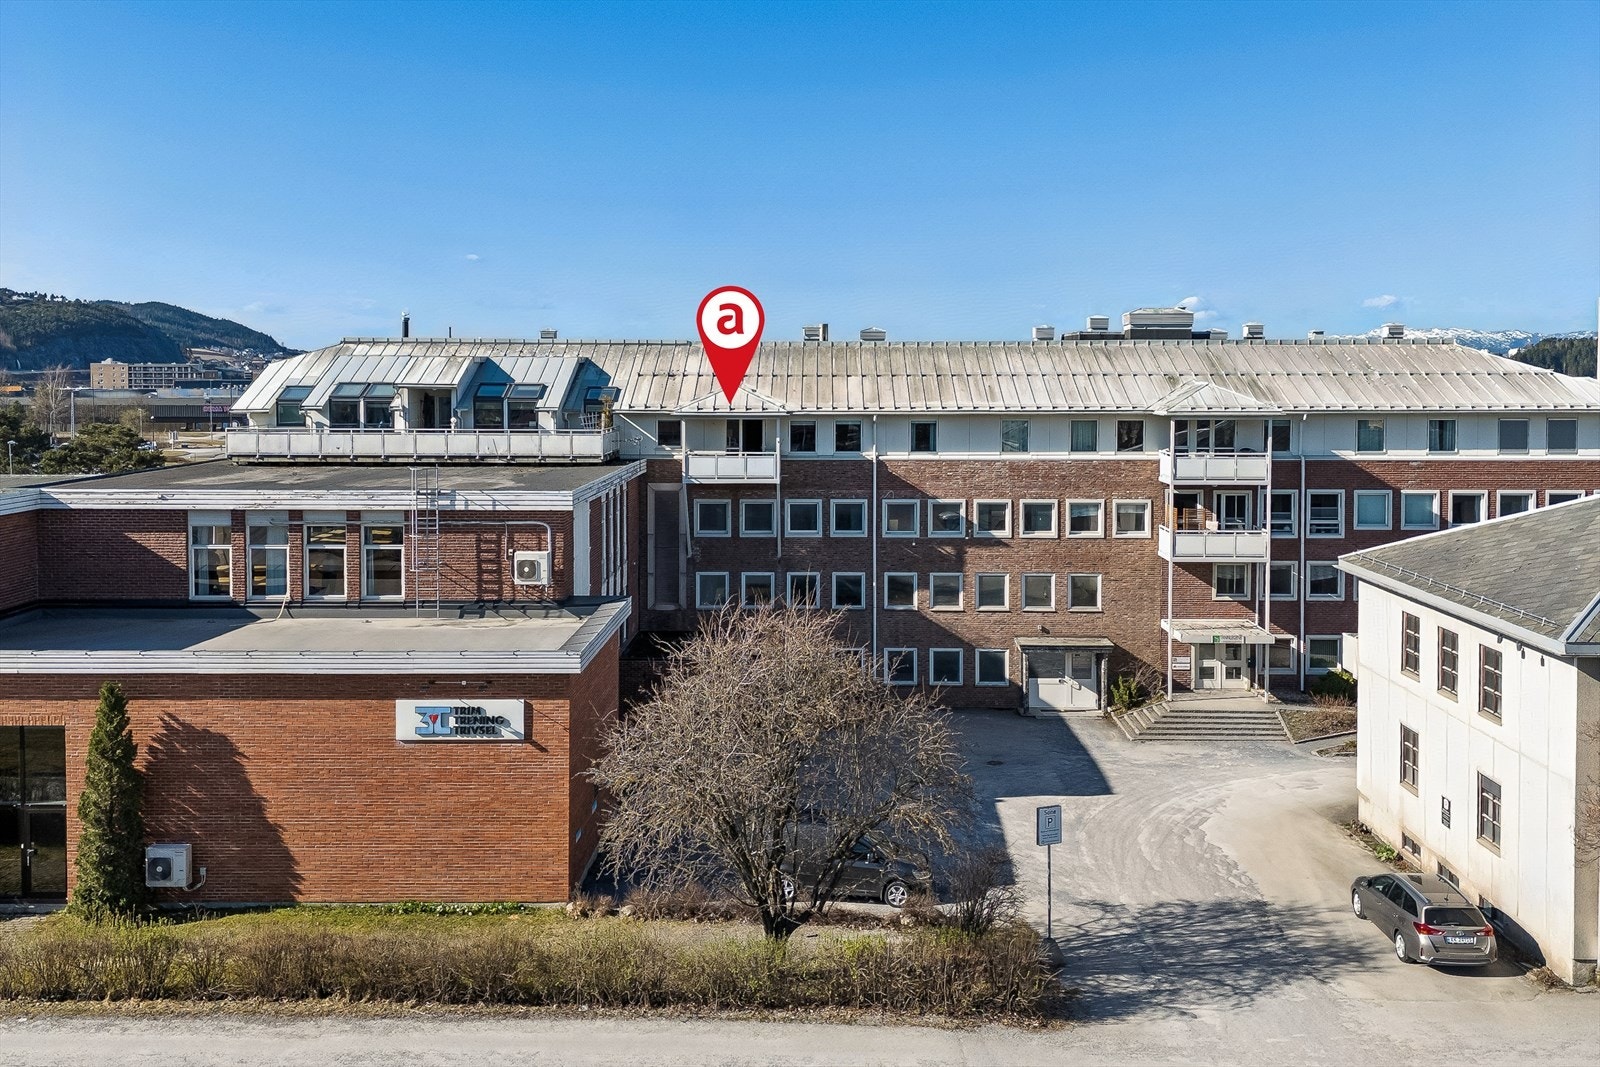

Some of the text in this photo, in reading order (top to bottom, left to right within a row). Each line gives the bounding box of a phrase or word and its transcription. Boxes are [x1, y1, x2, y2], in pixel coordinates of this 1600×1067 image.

[453, 706, 482, 716] TRIM
[453, 715, 505, 725] TRENING
[453, 725, 499, 735] TRIVSEL
[1047, 817, 1053, 827] P
